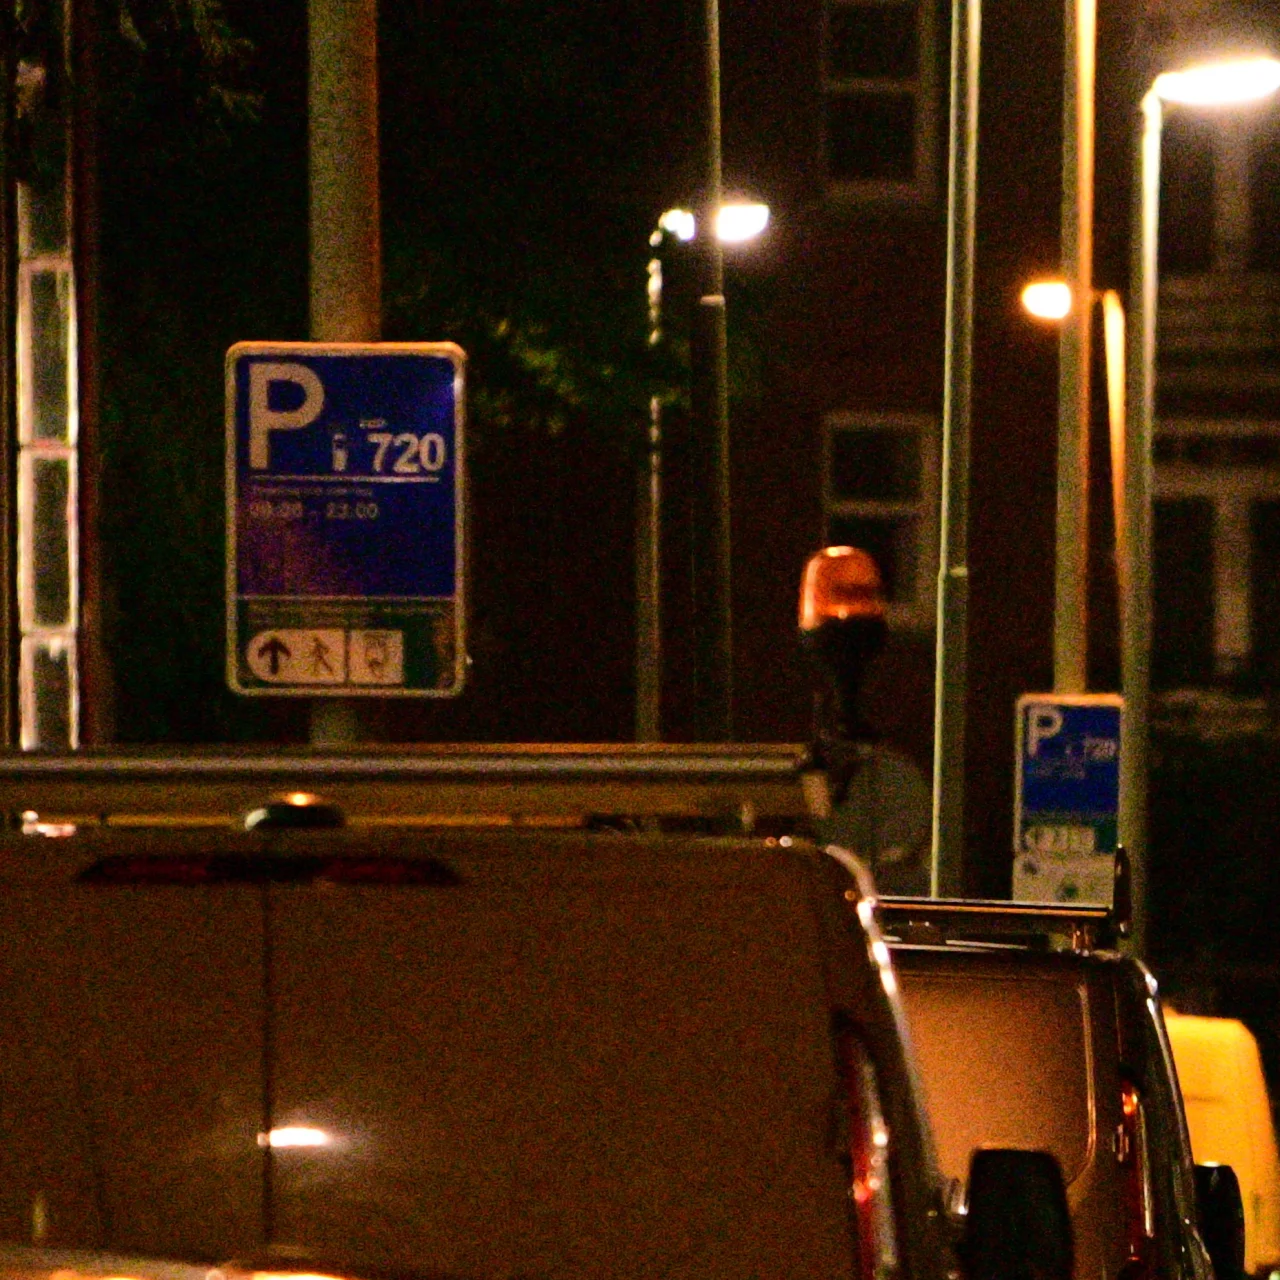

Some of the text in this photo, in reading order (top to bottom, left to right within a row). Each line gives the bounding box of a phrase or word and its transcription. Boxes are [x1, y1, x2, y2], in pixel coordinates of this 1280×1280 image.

[248, 360, 446, 473] P 720
[1028, 705, 1062, 757] P
